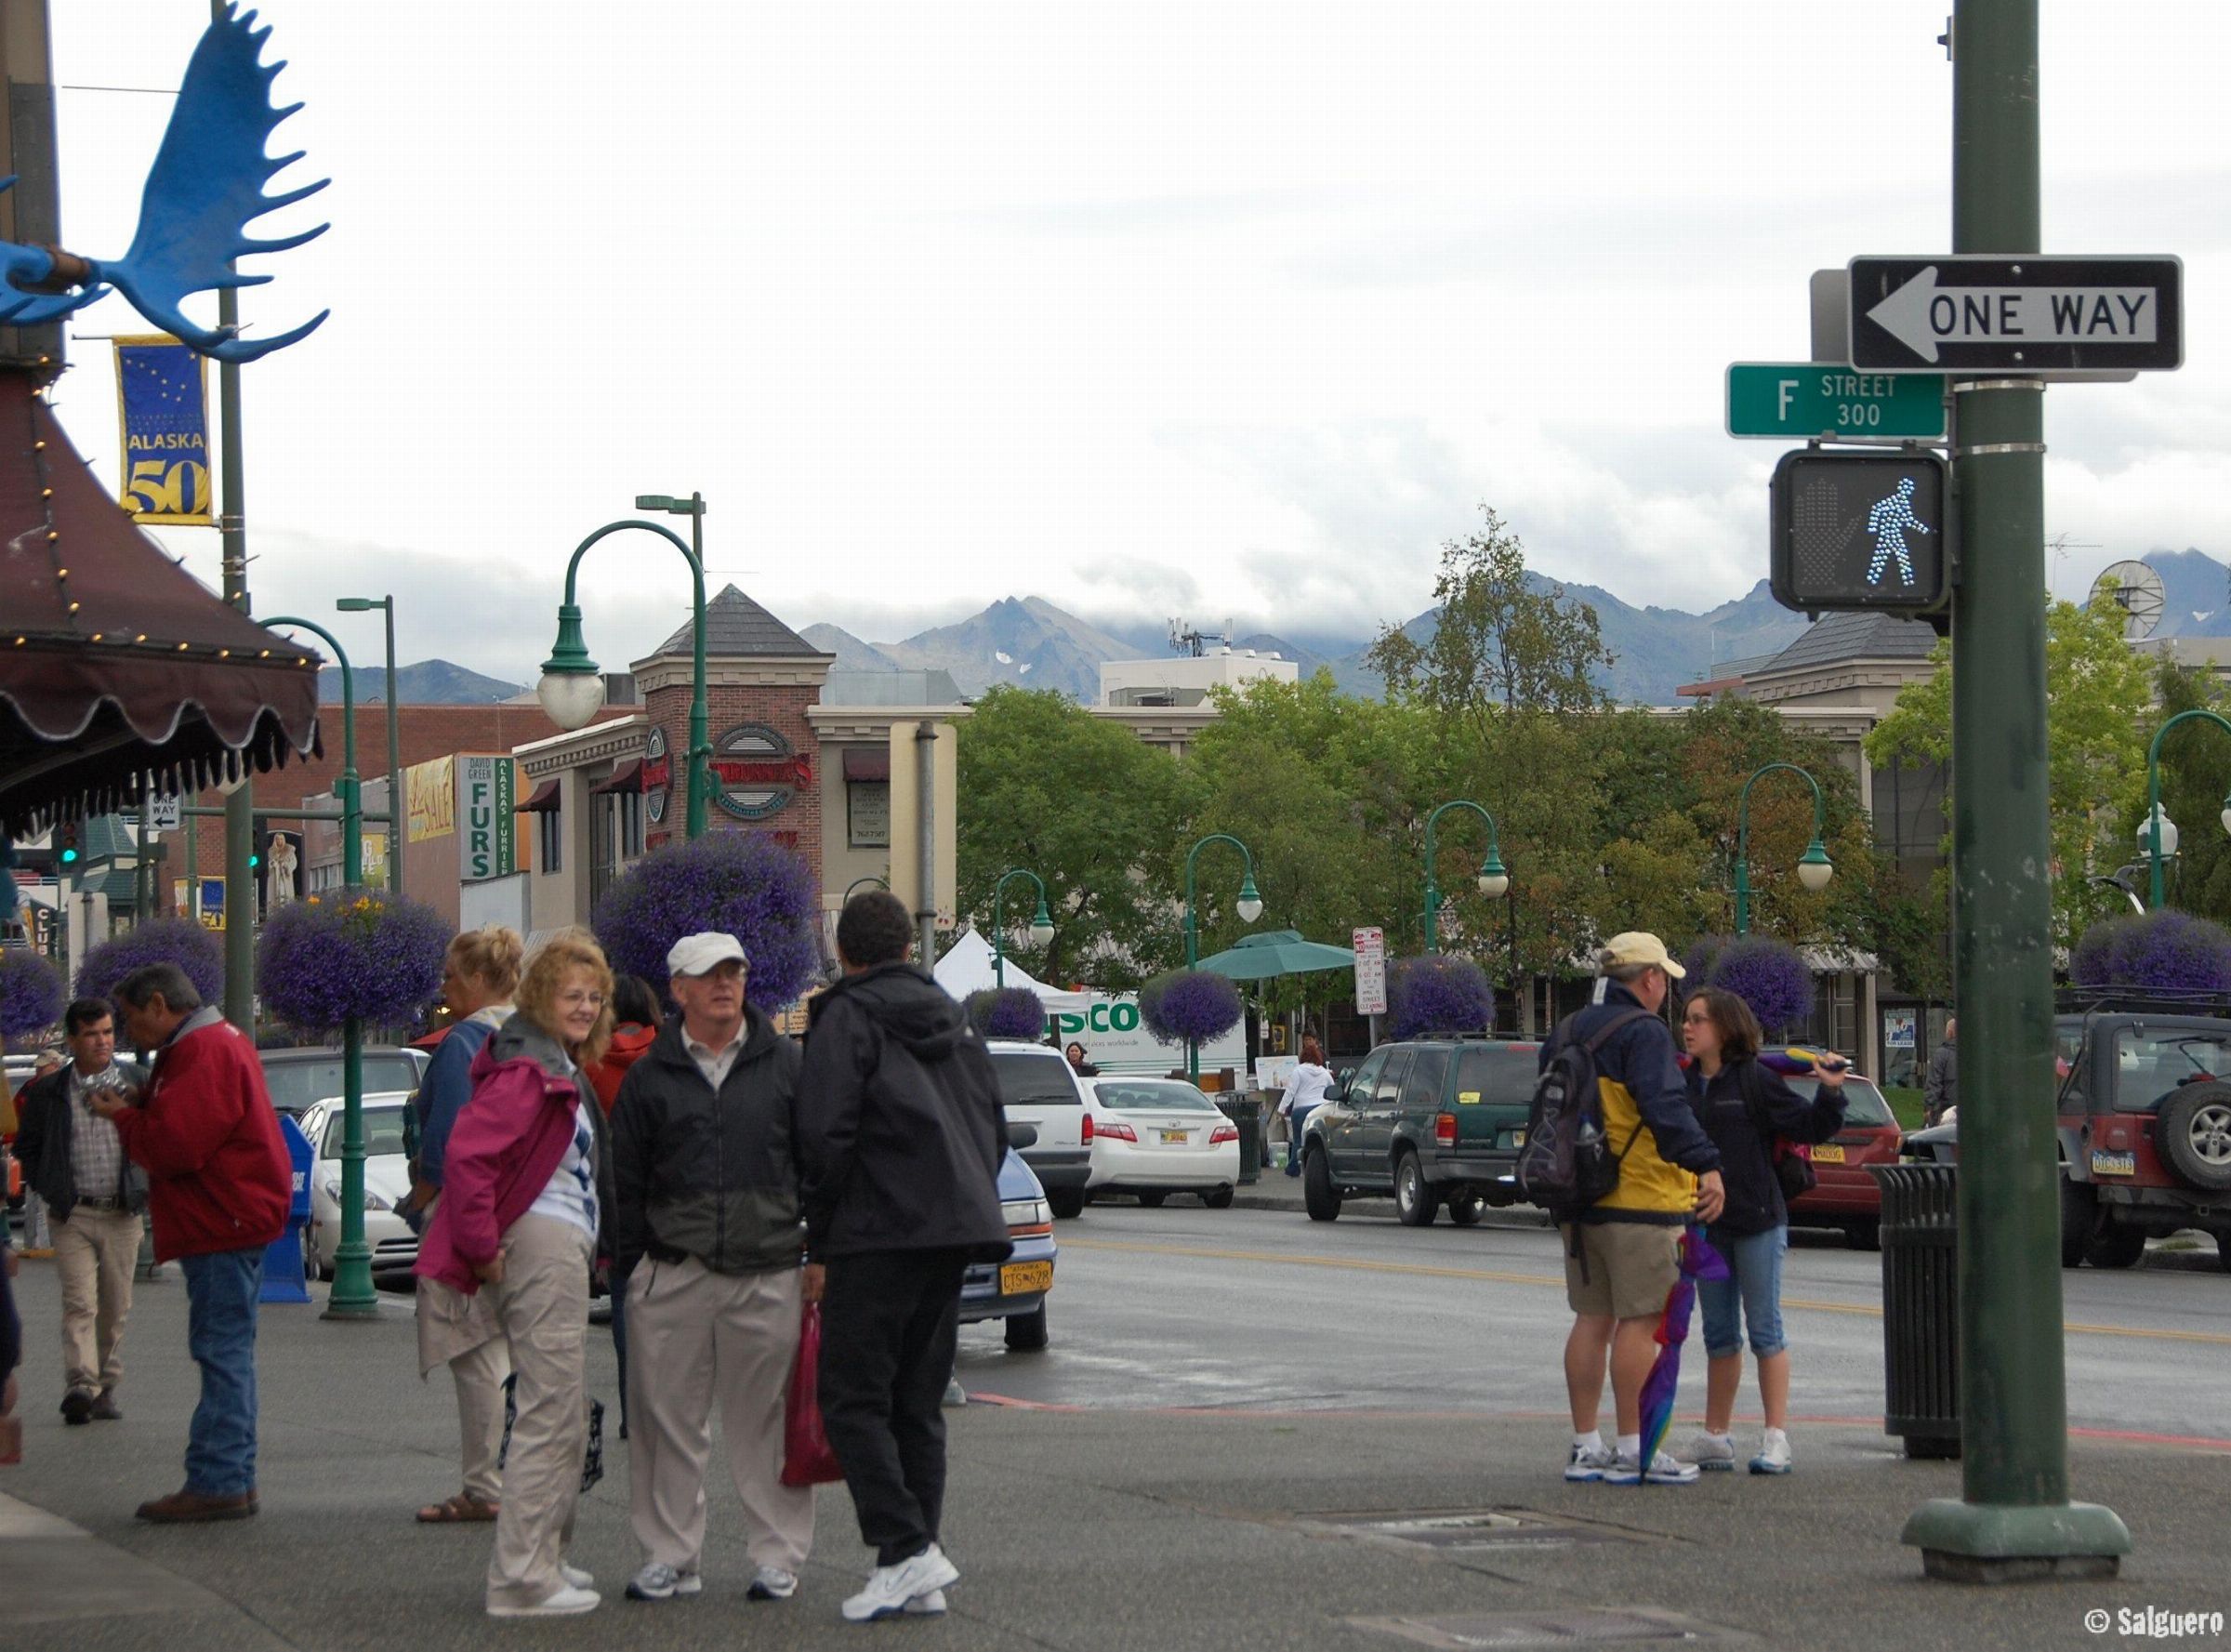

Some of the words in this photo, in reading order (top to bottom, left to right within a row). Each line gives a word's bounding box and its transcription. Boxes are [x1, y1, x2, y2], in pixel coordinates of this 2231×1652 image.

[1930, 294, 2024, 336] ONE
[2051, 294, 2148, 336] WAY
[1777, 379, 1800, 421] F
[1821, 375, 1896, 398] STREET
[1837, 404, 1881, 427] 300
[128, 433, 205, 450] ALASKA
[124, 459, 209, 514] 50
[469, 759, 491, 769] DAVID
[469, 769, 492, 780] GREEN
[152, 794, 175, 805] ONE
[152, 805, 176, 815] WAY
[471, 783, 490, 878] FURS
[37, 907, 49, 957] CLUB
